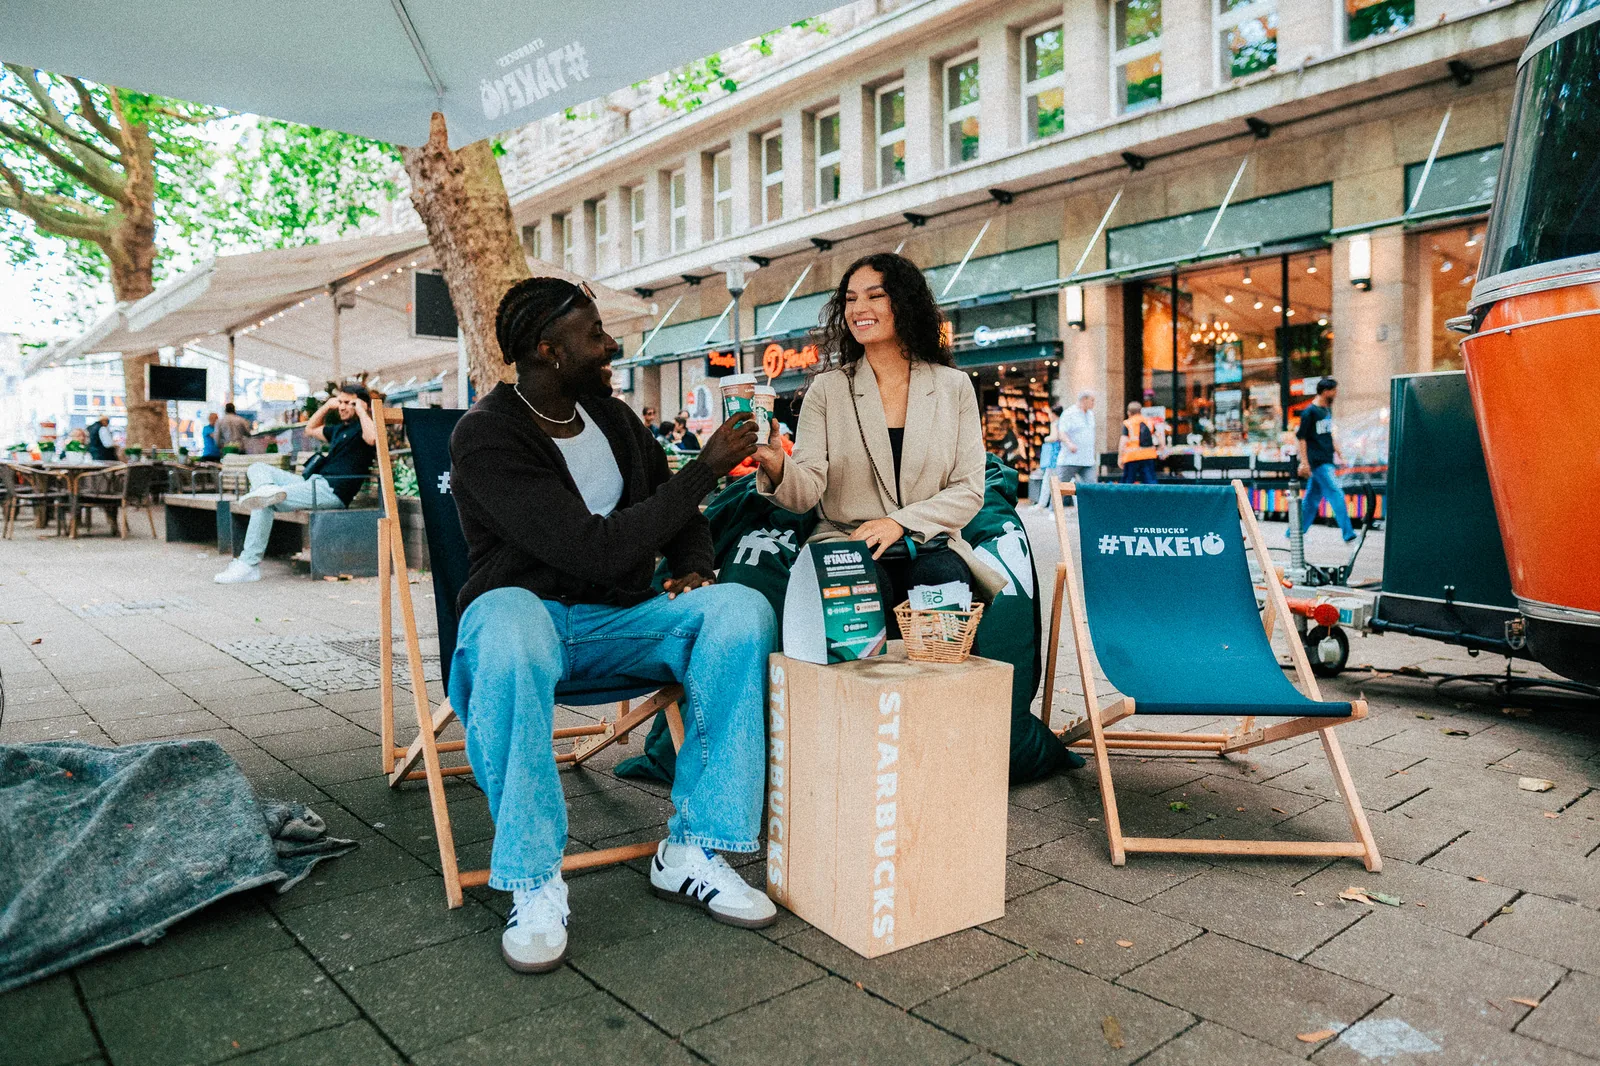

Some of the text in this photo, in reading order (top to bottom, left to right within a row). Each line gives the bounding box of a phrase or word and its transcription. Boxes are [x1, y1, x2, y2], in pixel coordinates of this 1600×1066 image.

[1098, 531, 1225, 557] #TAKE10
[823, 551, 863, 566] #TAKE10
[932, 588, 944, 604] 70
[768, 663, 785, 890] STARBUCKS
[872, 691, 901, 941] STARBUCKS
